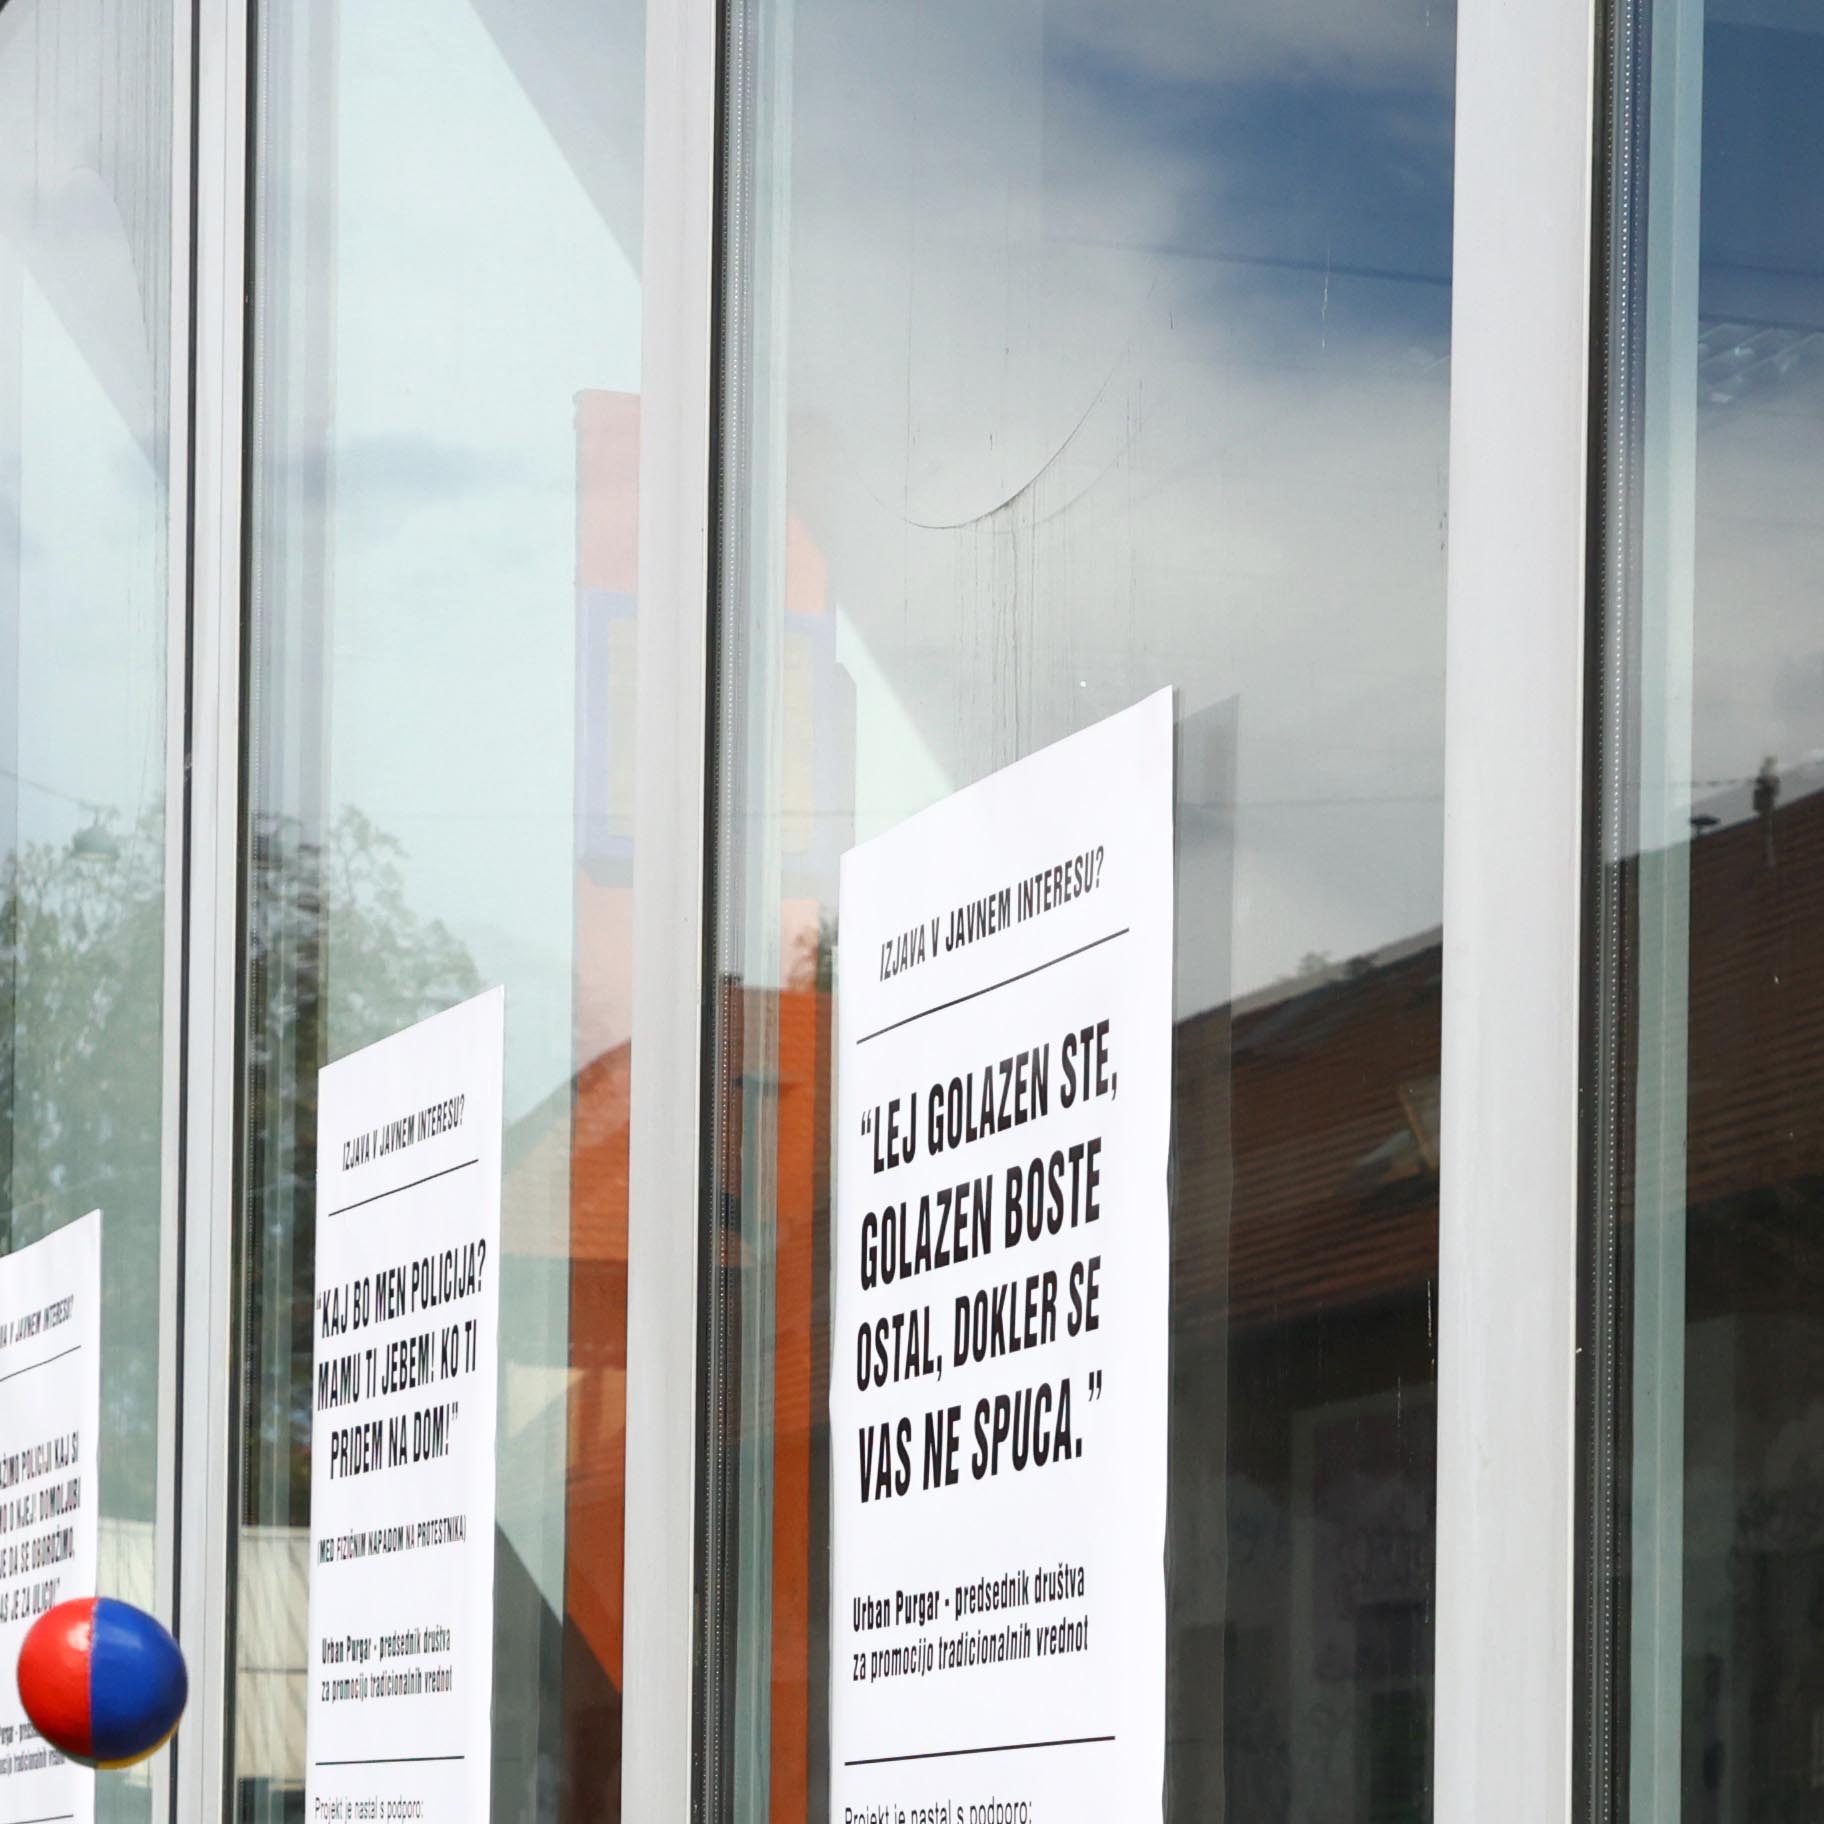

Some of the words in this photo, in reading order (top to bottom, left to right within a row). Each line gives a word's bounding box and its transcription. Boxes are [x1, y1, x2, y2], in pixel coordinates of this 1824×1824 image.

[879, 924, 926, 982] IZJAVA
[931, 916, 940, 958] V
[945, 887, 1011, 953] JAVNEM
[1017, 845, 1104, 923] INTERESU?
[343, 1133, 370, 1171] IZJAVA
[373, 1130, 378, 1160] V
[380, 1115, 415, 1158] JAVNEM
[418, 1093, 465, 1142] INTERESU?
[860, 1092, 917, 1175] “LEJ
[927, 1043, 1050, 1157] GOLAZEN
[1060, 1019, 1118, 1109] STE,
[860, 1174, 993, 1292] GOLAZEN
[1004, 1136, 1102, 1249] BOSTE
[353, 1277, 370, 1330] BO
[375, 1265, 406, 1323] MEN
[412, 1238, 486, 1313] POLICIJA?
[856, 1305, 943, 1392] OSTAL,
[953, 1270, 1058, 1368] DOKLER
[1067, 1255, 1101, 1338] SE
[318, 1353, 361, 1411] MAMU
[366, 1348, 377, 1399] TI
[382, 1332, 435, 1395] JEBEM!
[441, 1324, 459, 1380] KO
[465, 1319, 477, 1373] TI
[55, 1434, 70, 1469] KAJ
[330, 1420, 383, 1479] PRIDEM
[389, 1415, 408, 1468] NA
[858, 1416, 912, 1504] VAS
[922, 1405, 962, 1491] NE
[971, 1369, 1103, 1481] SPUCA.”
[853, 1594, 891, 1633] Urban
[895, 1589, 940, 1627] Purgar
[954, 1569, 1030, 1622] predsednik
[1034, 1562, 1085, 1604] društva
[322, 1637, 344, 1664] Urban
[347, 1635, 371, 1663] Purgar
[380, 1627, 421, 1662] predsednik
[852, 1652, 867, 1682] za
[870, 1637, 934, 1684] promocijo
[938, 1622, 1032, 1671] tradicionalnih
[1036, 1614, 1089, 1657] vrednot
